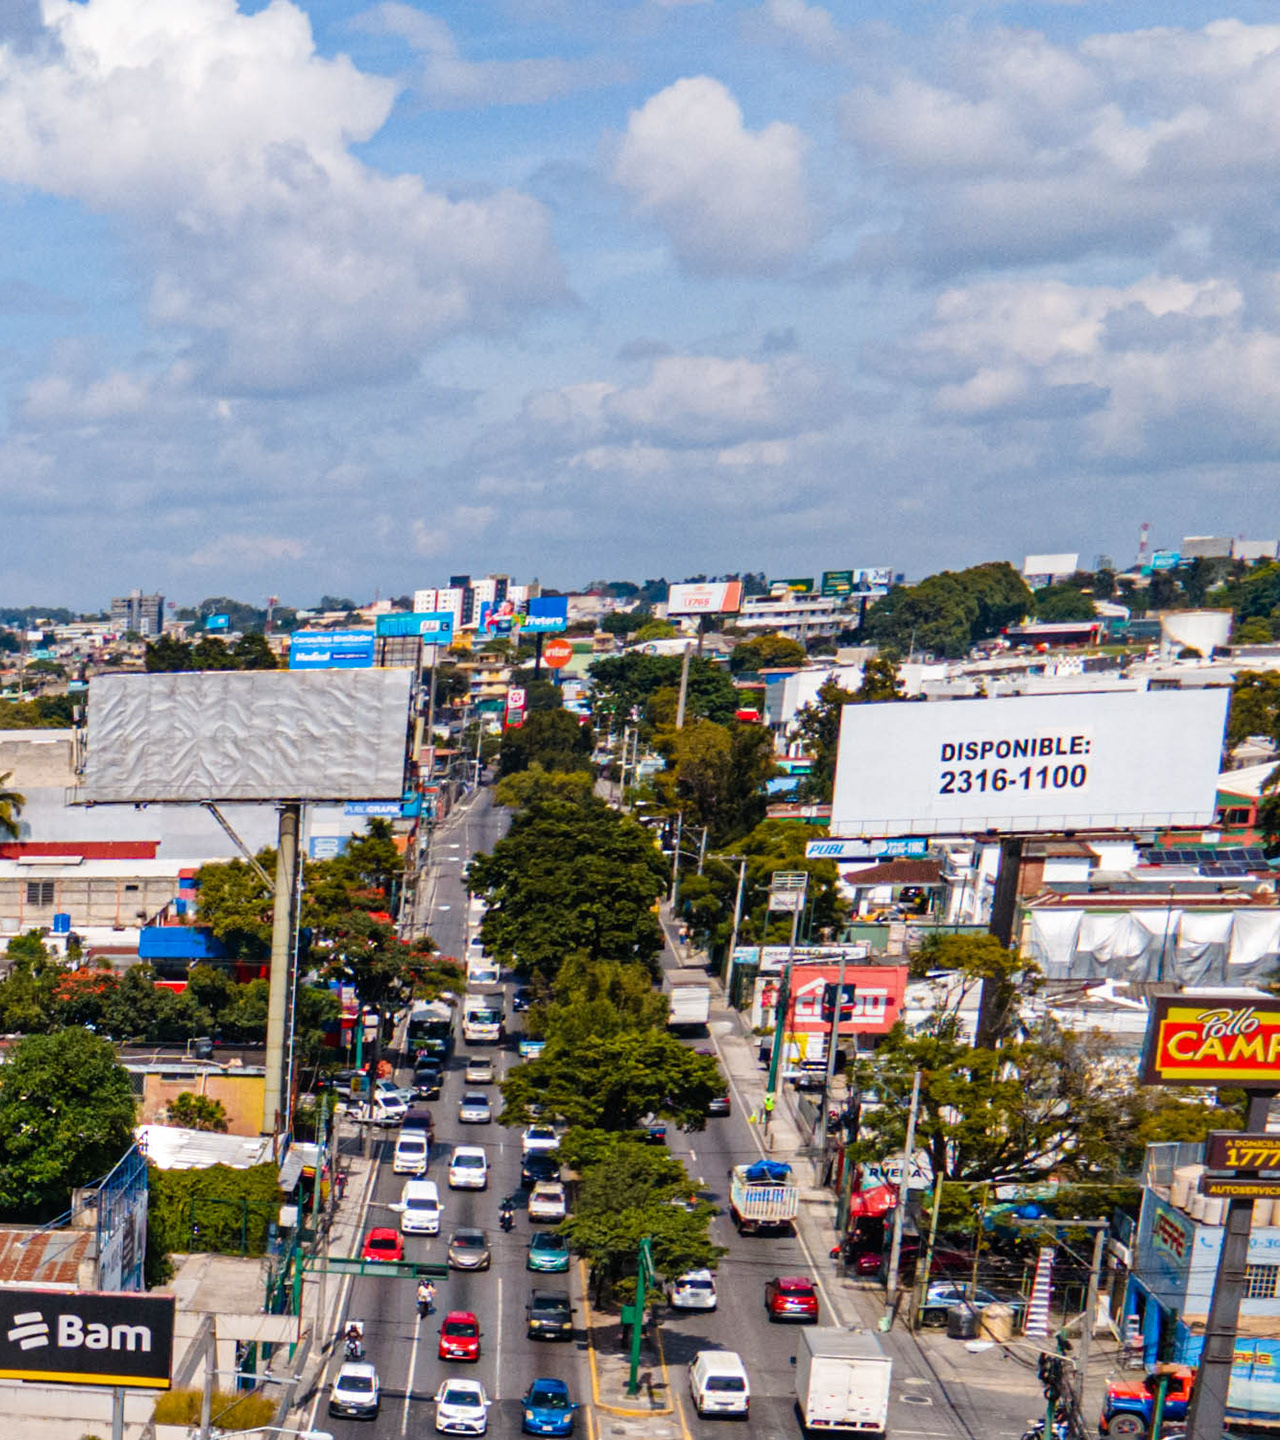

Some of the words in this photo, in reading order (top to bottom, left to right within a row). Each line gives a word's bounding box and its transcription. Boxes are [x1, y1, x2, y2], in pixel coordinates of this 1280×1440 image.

[941, 735, 1091, 762] DISPONIBLE:
[939, 764, 1087, 794] 2316-1100
[1197, 1007, 1261, 1041] Pollo
[57, 1314, 152, 1352] Bam
